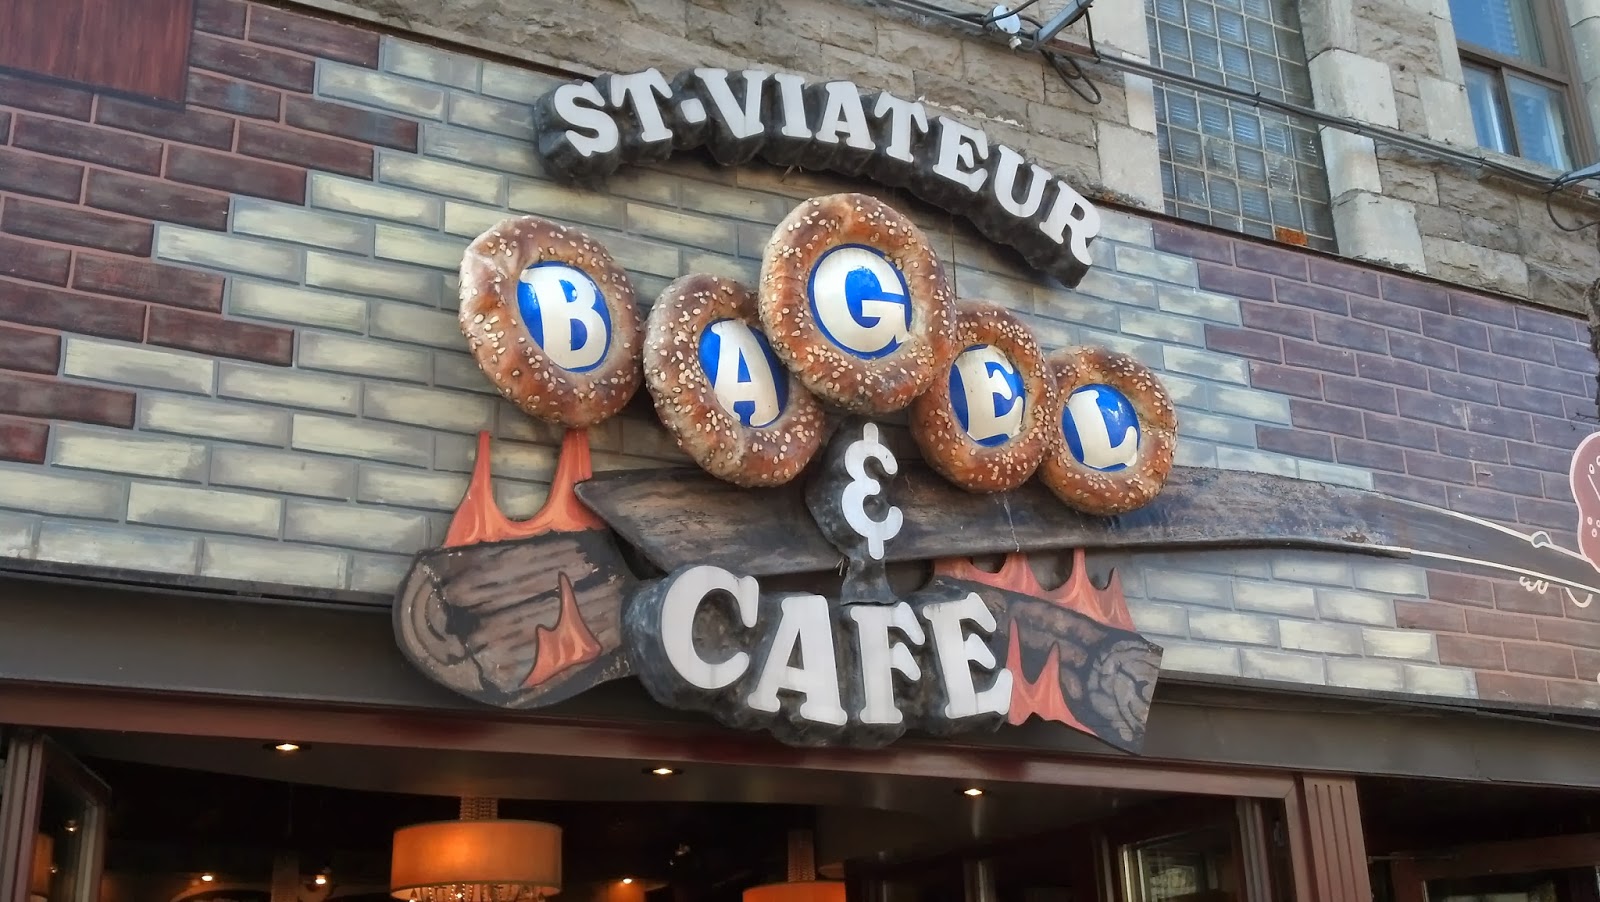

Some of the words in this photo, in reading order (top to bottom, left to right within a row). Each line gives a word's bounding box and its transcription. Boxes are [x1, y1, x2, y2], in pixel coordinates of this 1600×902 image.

[520, 246, 1139, 471] BAGEL
[841, 422, 903, 560] &
[661, 565, 1013, 726] CAFE
